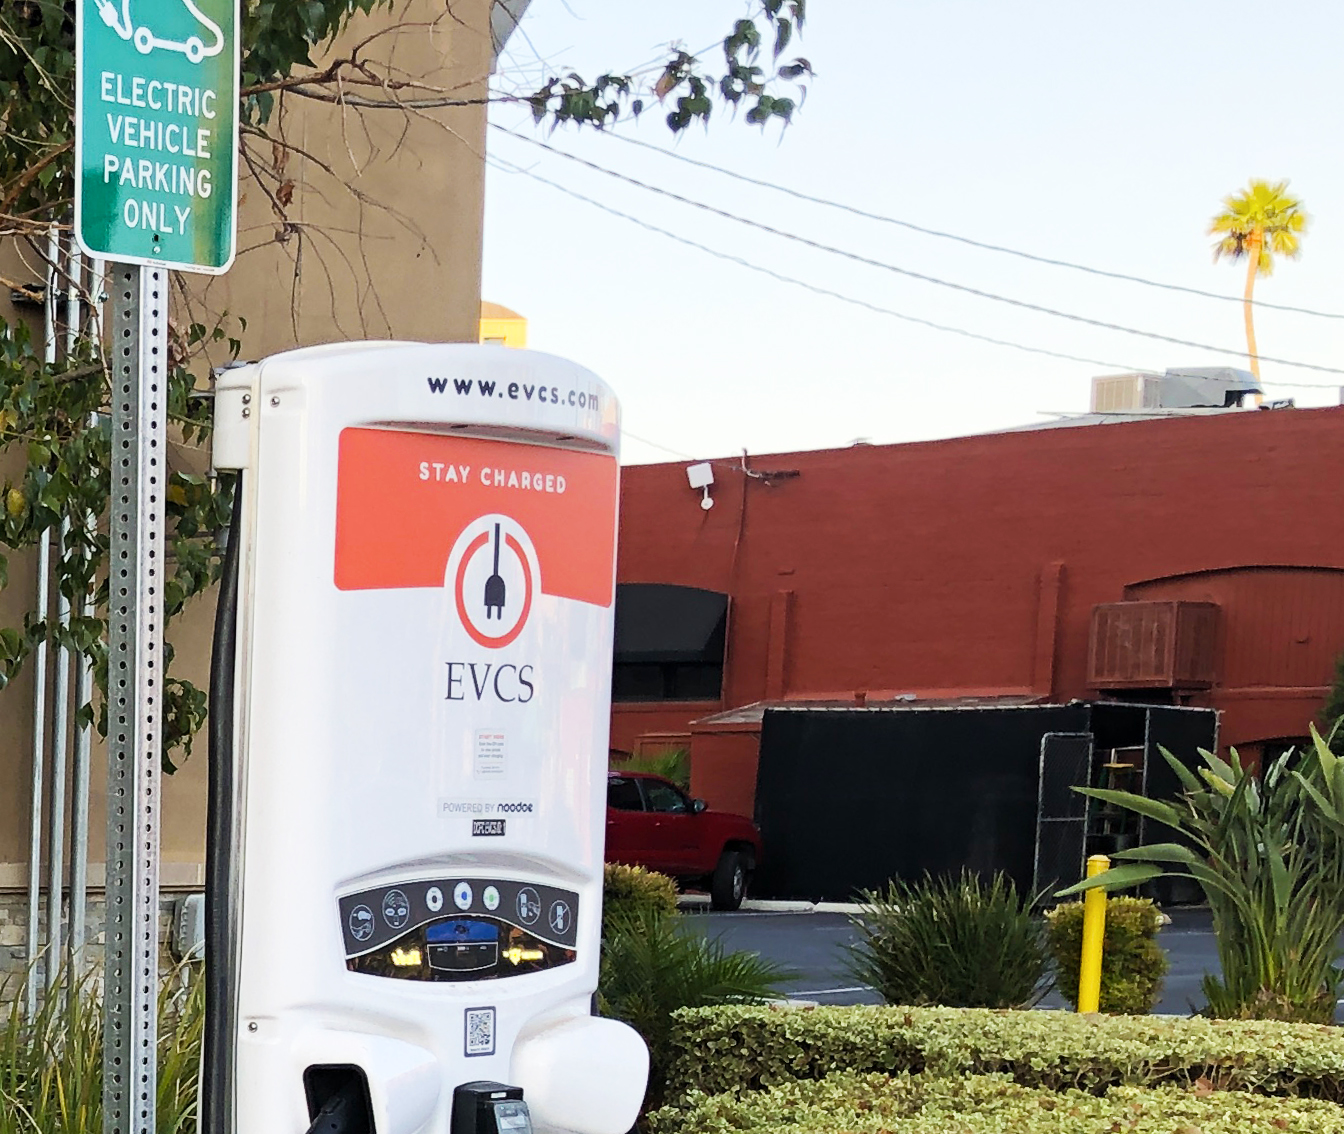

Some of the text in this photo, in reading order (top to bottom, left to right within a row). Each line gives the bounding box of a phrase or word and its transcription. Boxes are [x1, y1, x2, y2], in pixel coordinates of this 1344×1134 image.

[100, 71, 216, 119] ELECTRIC
[107, 113, 211, 159] VEHICLE
[104, 154, 212, 198] PARKING
[123, 198, 191, 235] ONLY
[426, 376, 599, 412] www.evcs.com
[419, 461, 567, 494] STAY CHARGED
[444, 662, 535, 703] EVCS
[443, 802, 482, 813] POWERED
[484, 803, 495, 813] BY
